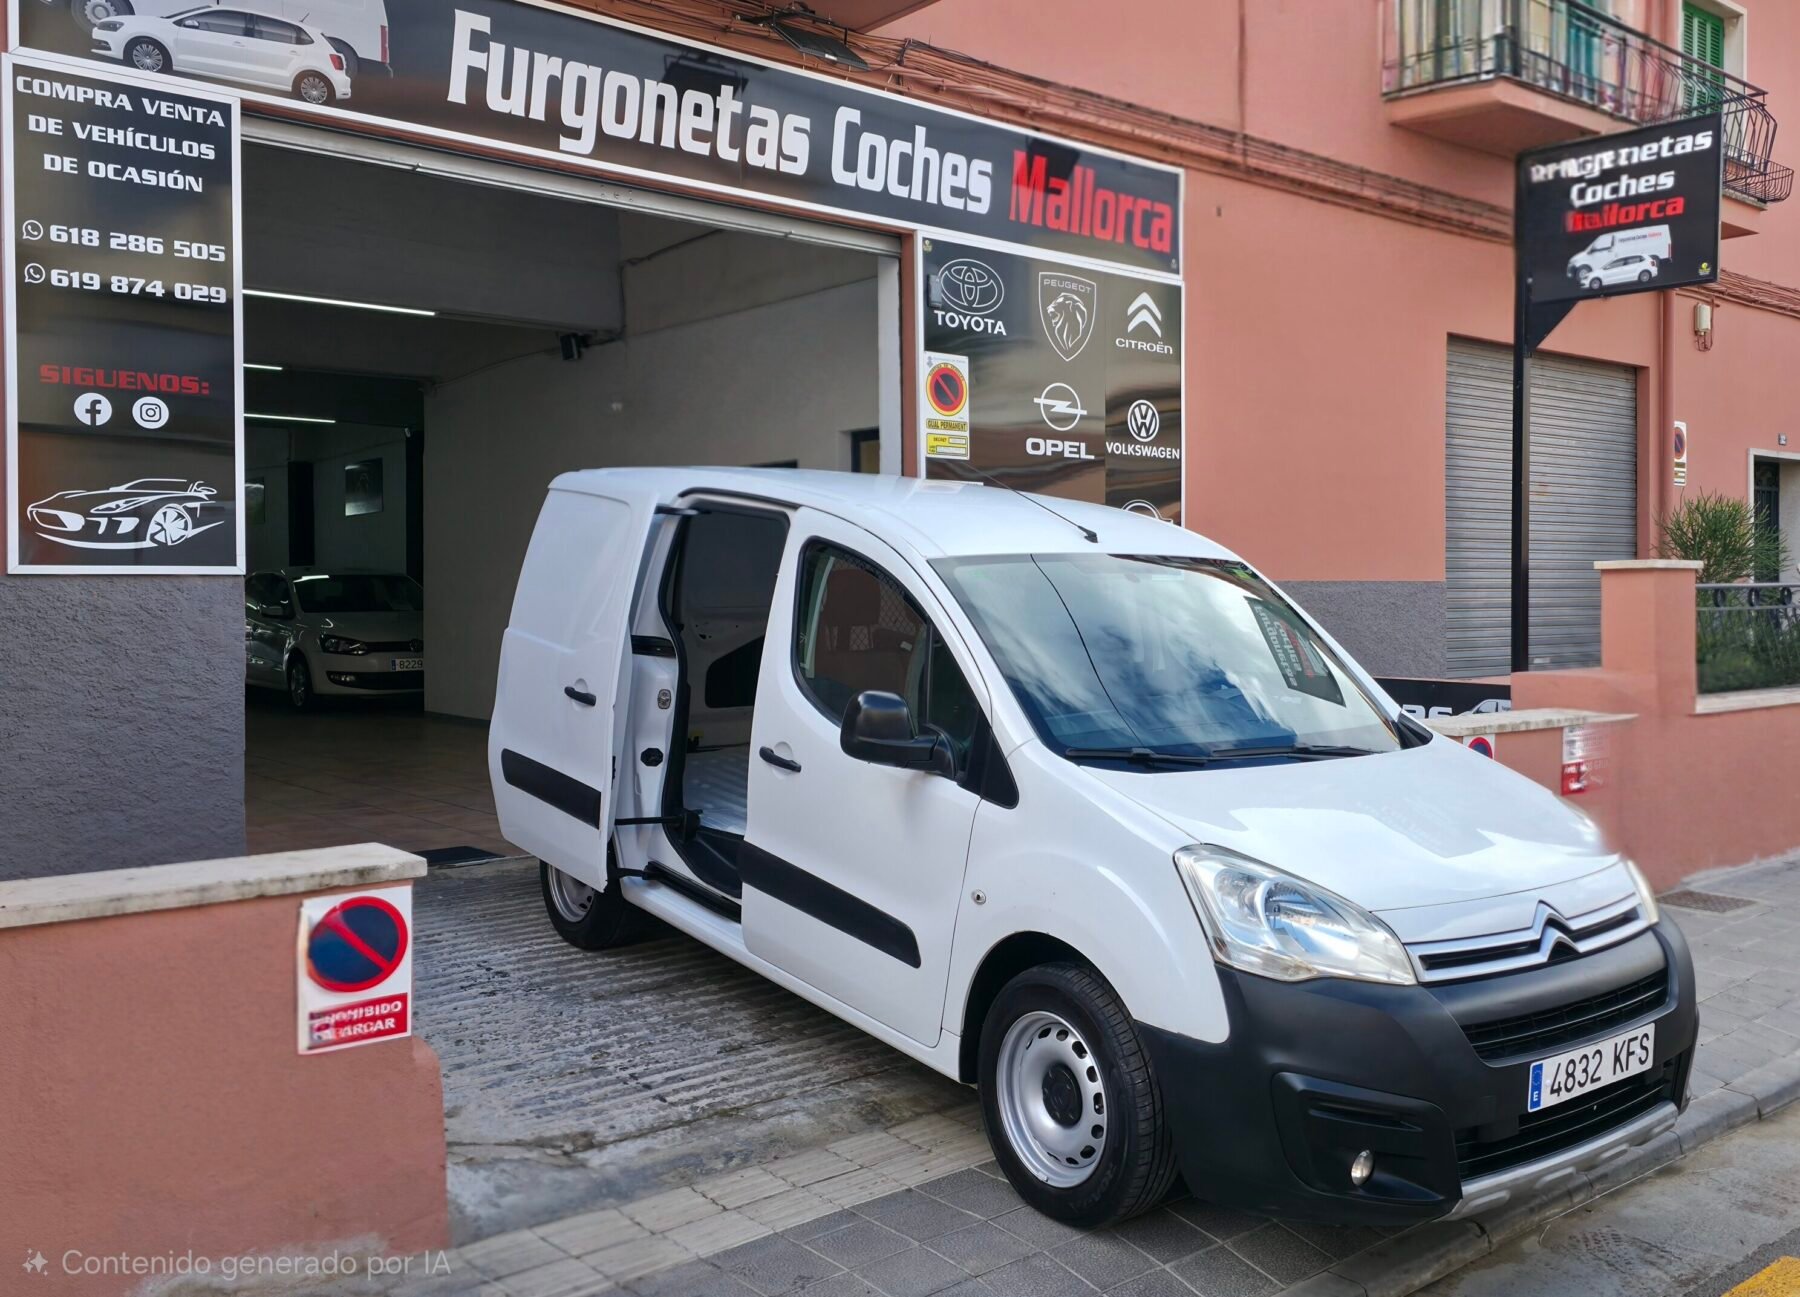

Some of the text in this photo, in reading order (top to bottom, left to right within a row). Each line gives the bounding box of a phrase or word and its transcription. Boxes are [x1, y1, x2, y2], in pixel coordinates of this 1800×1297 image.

[16, 76, 226, 127] COMPRA VENTA
[28, 114, 216, 160] DE VEHÍCULOS
[447, 9, 1174, 254] Furgonetas Coches Mallorca
[43, 153, 203, 193] DE OCASIÓN
[1569, 170, 1676, 209] Coches
[49, 224, 226, 262] 618 286 505
[50, 269, 227, 304] 619 874 029
[1043, 278, 1093, 294] PEUGEOT
[933, 309, 1007, 336] TOYOTA
[39, 364, 210, 396] SIGUENOS:
[1025, 437, 1095, 460] OPEL
[1105, 441, 1180, 460] VOLKSWAGEN
[399, 659, 423, 670] 8229
[1549, 1032, 1650, 1097] 4832 KFS
[1532, 1090, 1539, 1102] E
